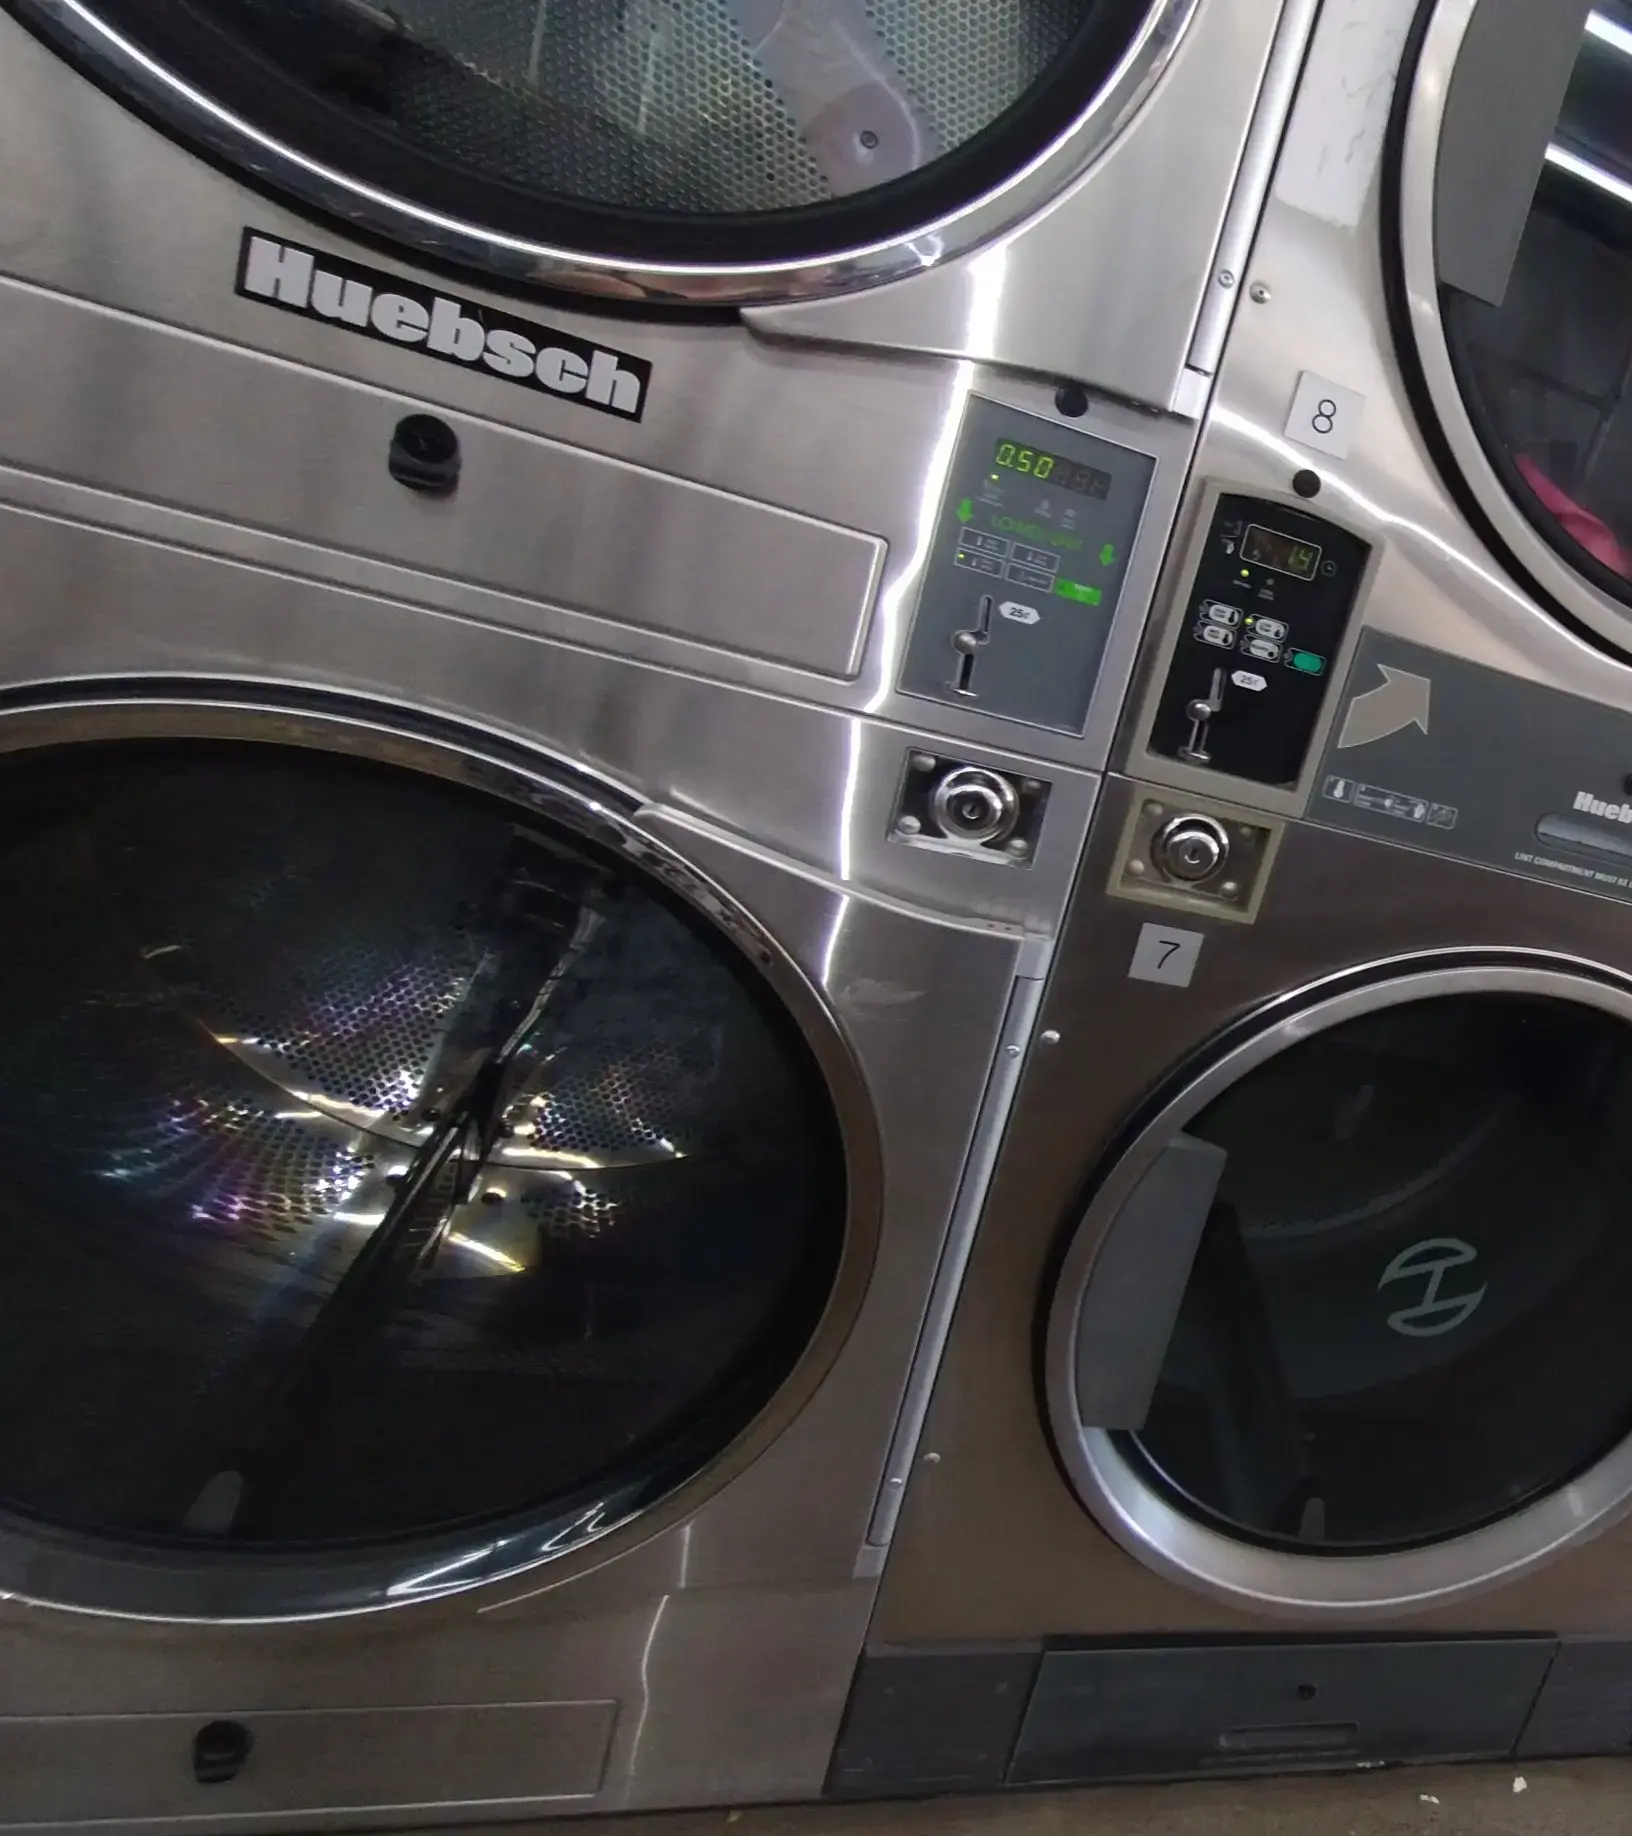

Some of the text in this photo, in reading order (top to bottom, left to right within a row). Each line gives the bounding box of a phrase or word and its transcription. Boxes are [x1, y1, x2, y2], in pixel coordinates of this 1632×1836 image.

[244, 236, 641, 414] Huebsch
[1312, 398, 1337, 434] 8
[1156, 940, 1181, 970] 7
